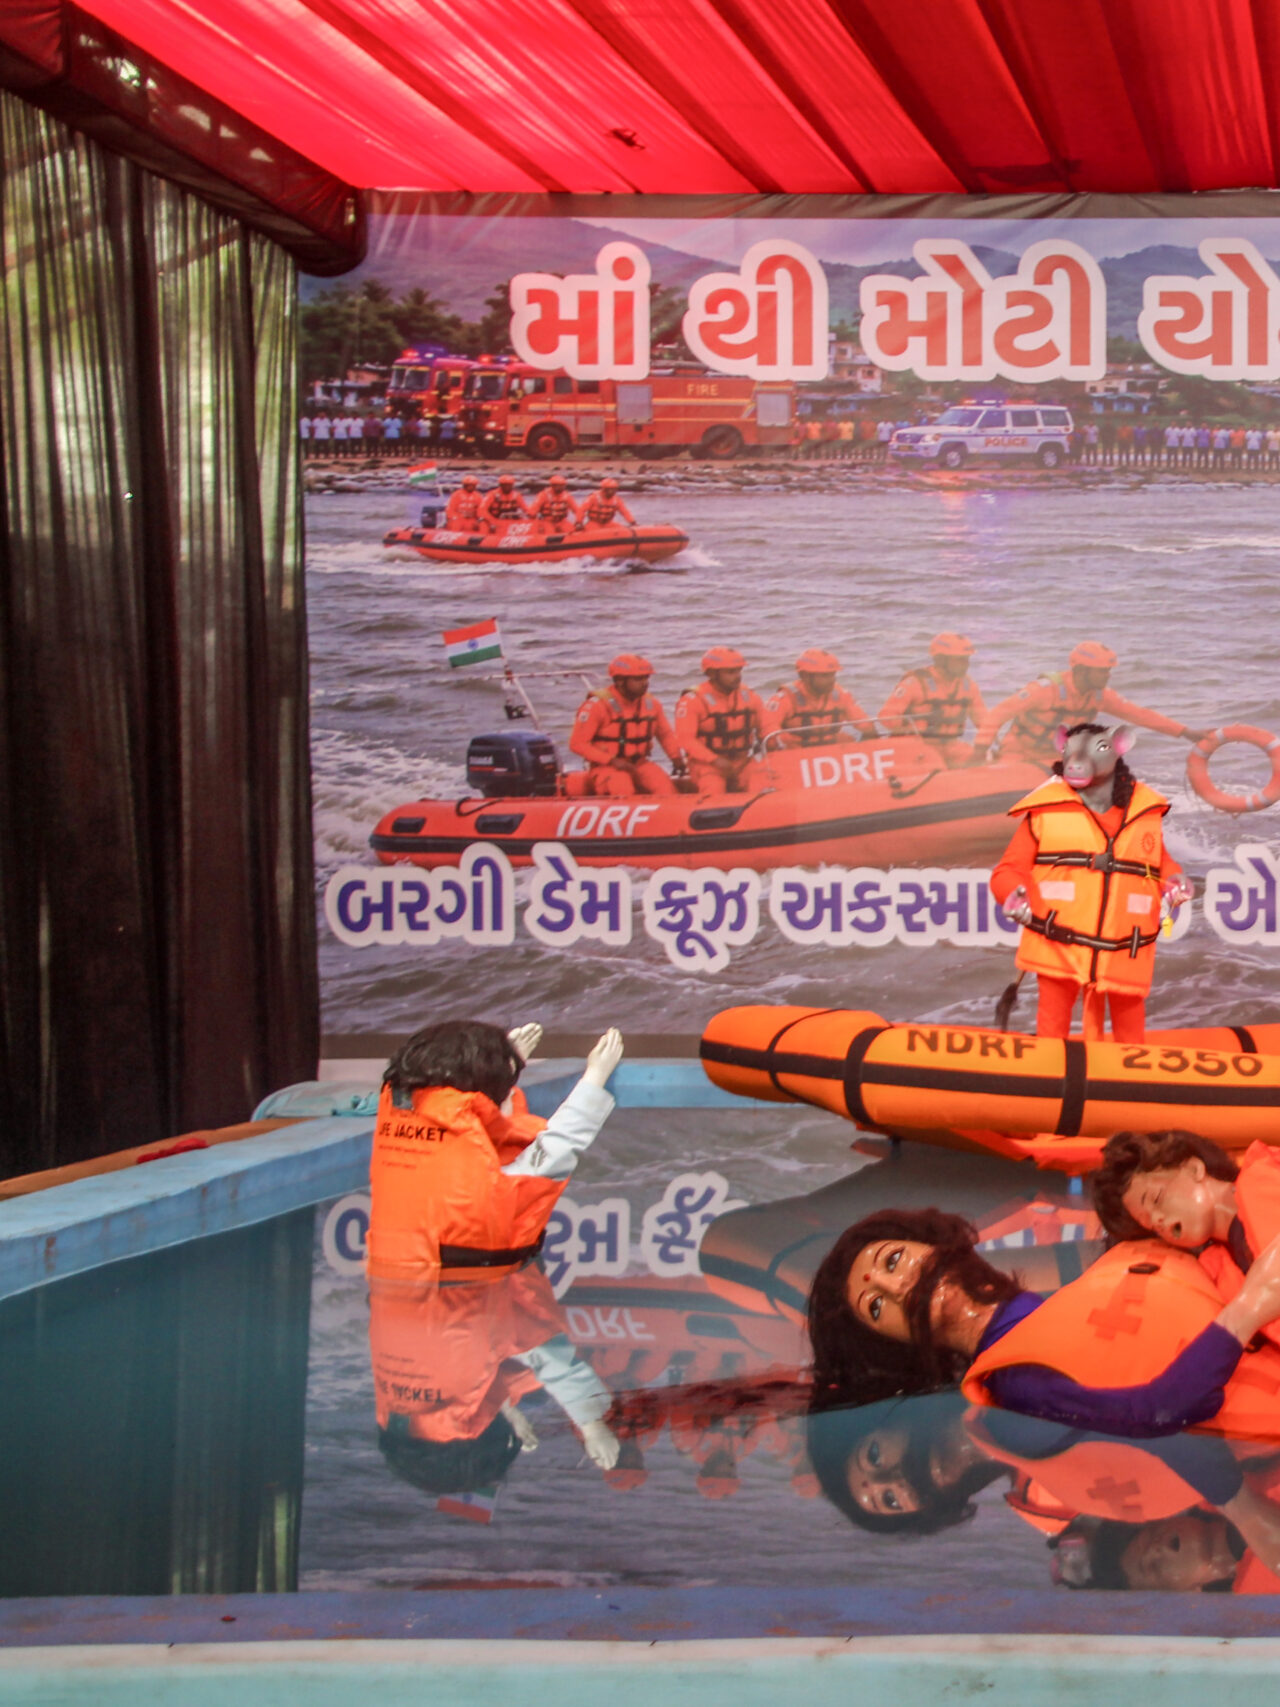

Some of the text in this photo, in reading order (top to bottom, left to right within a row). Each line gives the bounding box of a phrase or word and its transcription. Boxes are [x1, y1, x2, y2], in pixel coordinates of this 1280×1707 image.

[522, 252, 640, 370] માં
[694, 249, 818, 371] થી
[871, 249, 1095, 372] મોટી
[686, 383, 719, 397] FIRE
[984, 436, 1028, 448] POLICE
[800, 748, 896, 789] IDRF
[556, 804, 660, 838] IDRF
[333, 852, 507, 936] બરગી
[533, 852, 624, 936] ડેમ
[651, 877, 754, 962] ક્રૂઝ
[905, 1029, 1039, 1060] NDRF
[1120, 1044, 1264, 1078] 2350
[394, 1123, 448, 1142] JACKET
